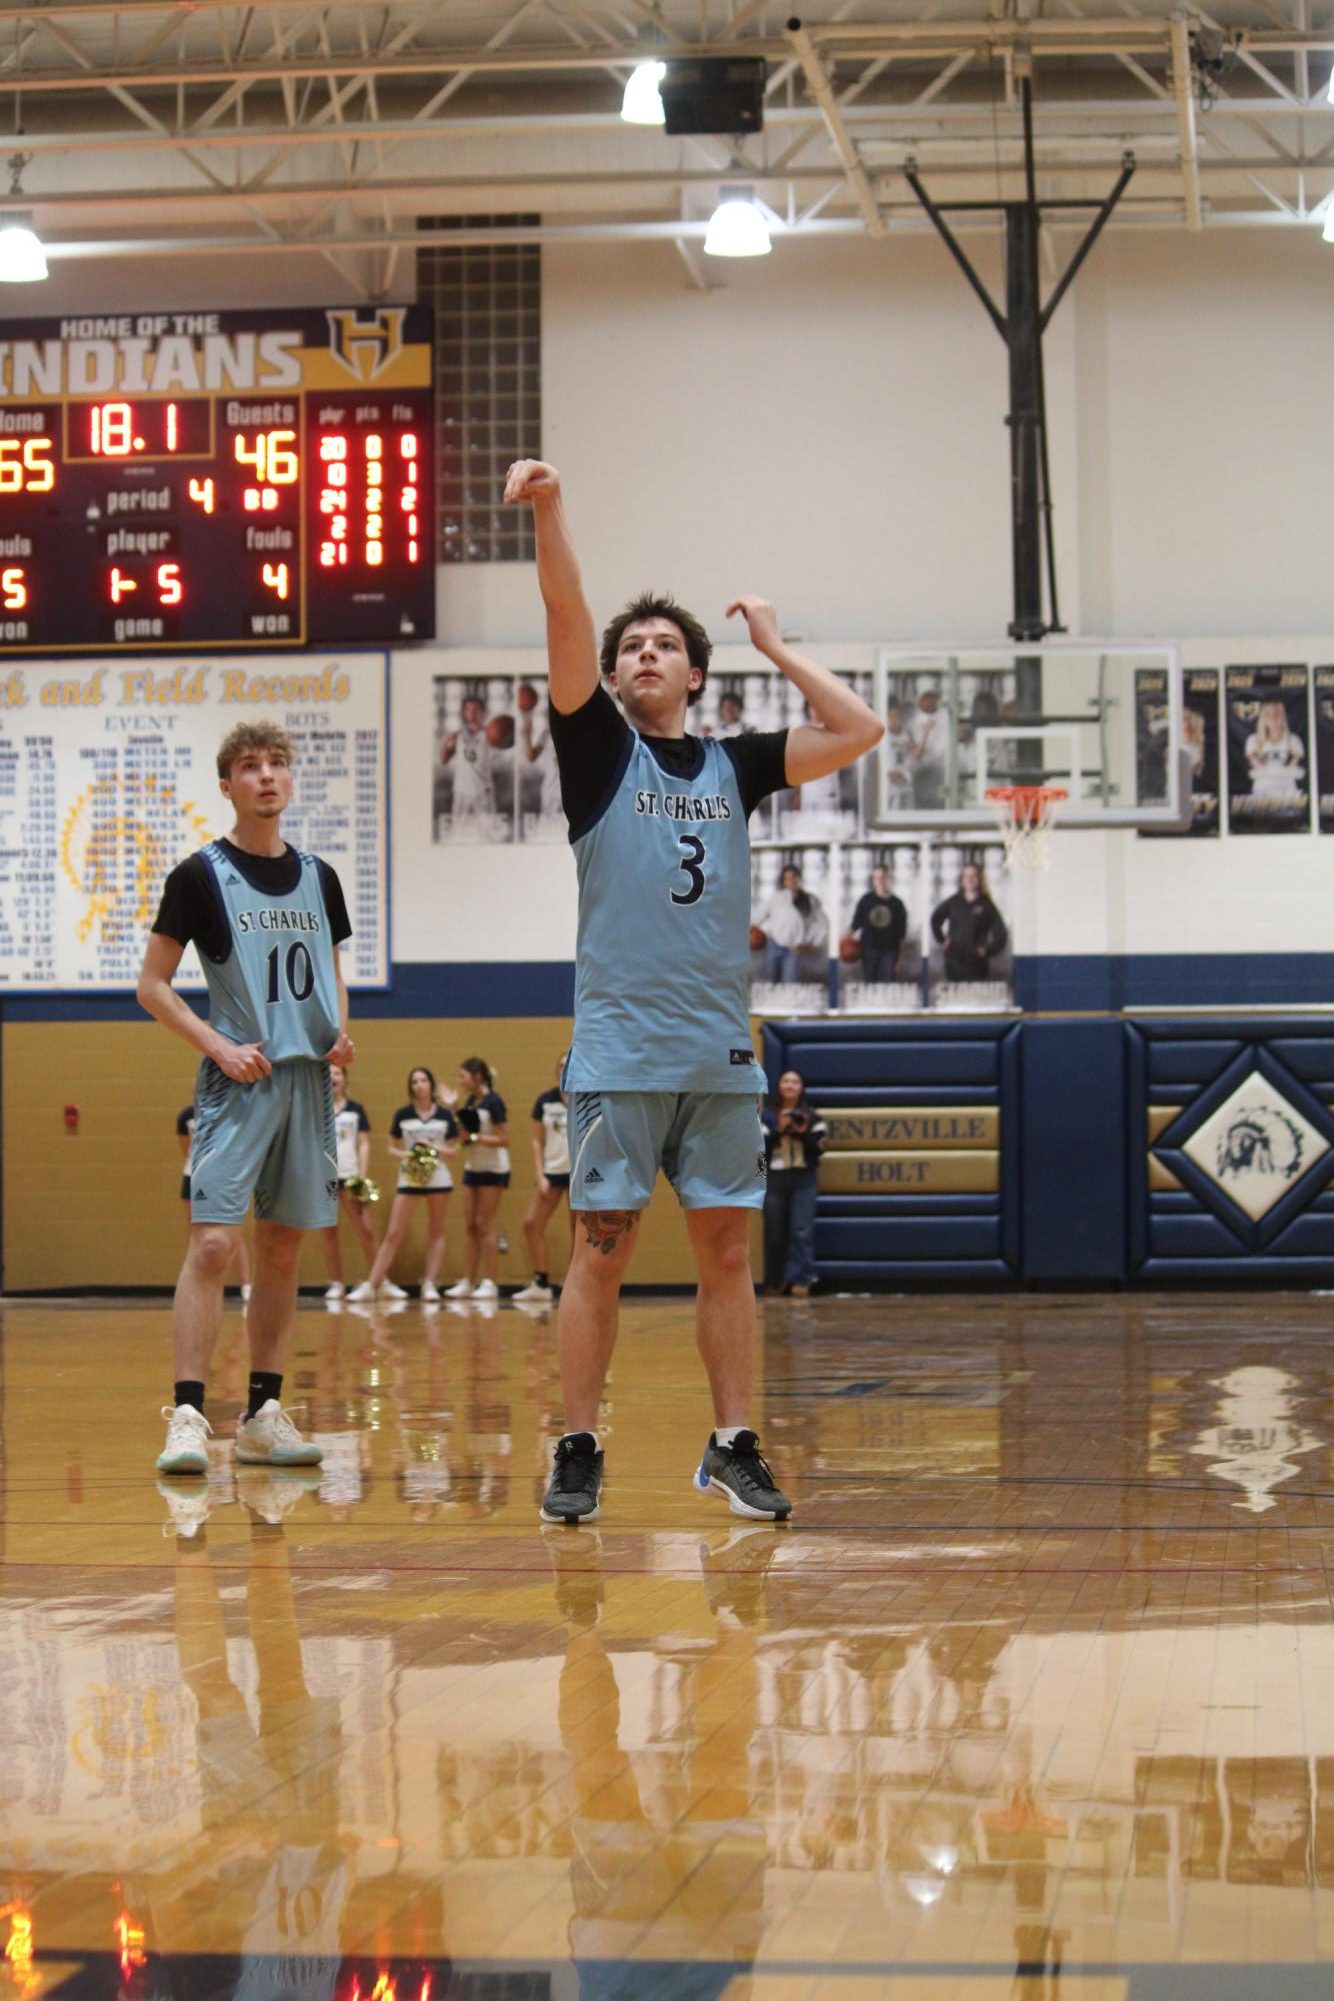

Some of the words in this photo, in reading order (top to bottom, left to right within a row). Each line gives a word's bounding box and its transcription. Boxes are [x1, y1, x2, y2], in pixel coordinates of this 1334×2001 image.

[61, 317, 132, 338] HOME
[136, 316, 169, 337] OF
[173, 314, 220, 334] THE
[0, 331, 303, 395] NDIANS
[227, 401, 295, 426] Guests
[235, 430, 298, 484] 46
[401, 433, 417, 458] 0
[408, 460, 417, 483] 1
[107, 486, 171, 516] period
[189, 477, 213, 514] 4
[401, 486, 417, 511] 2
[408, 513, 417, 536] 1
[107, 528, 171, 557] player
[246, 526, 292, 550] fouls
[408, 540, 417, 563] 1
[2, 568, 26, 609] 5
[158, 564, 182, 604] 5
[262, 563, 287, 600] 4
[114, 618, 164, 642] game
[251, 614, 290, 635] won
[40, 666, 108, 709] and
[117, 665, 210, 708] Field
[217, 662, 352, 706] Records
[104, 714, 178, 731] EVENT
[284, 711, 329, 726] BOYS
[635, 789, 660, 817] ST.
[669, 833, 707, 907] 3
[258, 908, 320, 934] CHARLES
[265, 940, 315, 1004] 10
[828, 1117, 986, 1139] ENTZVILLE
[857, 1160, 931, 1183] HOLT
